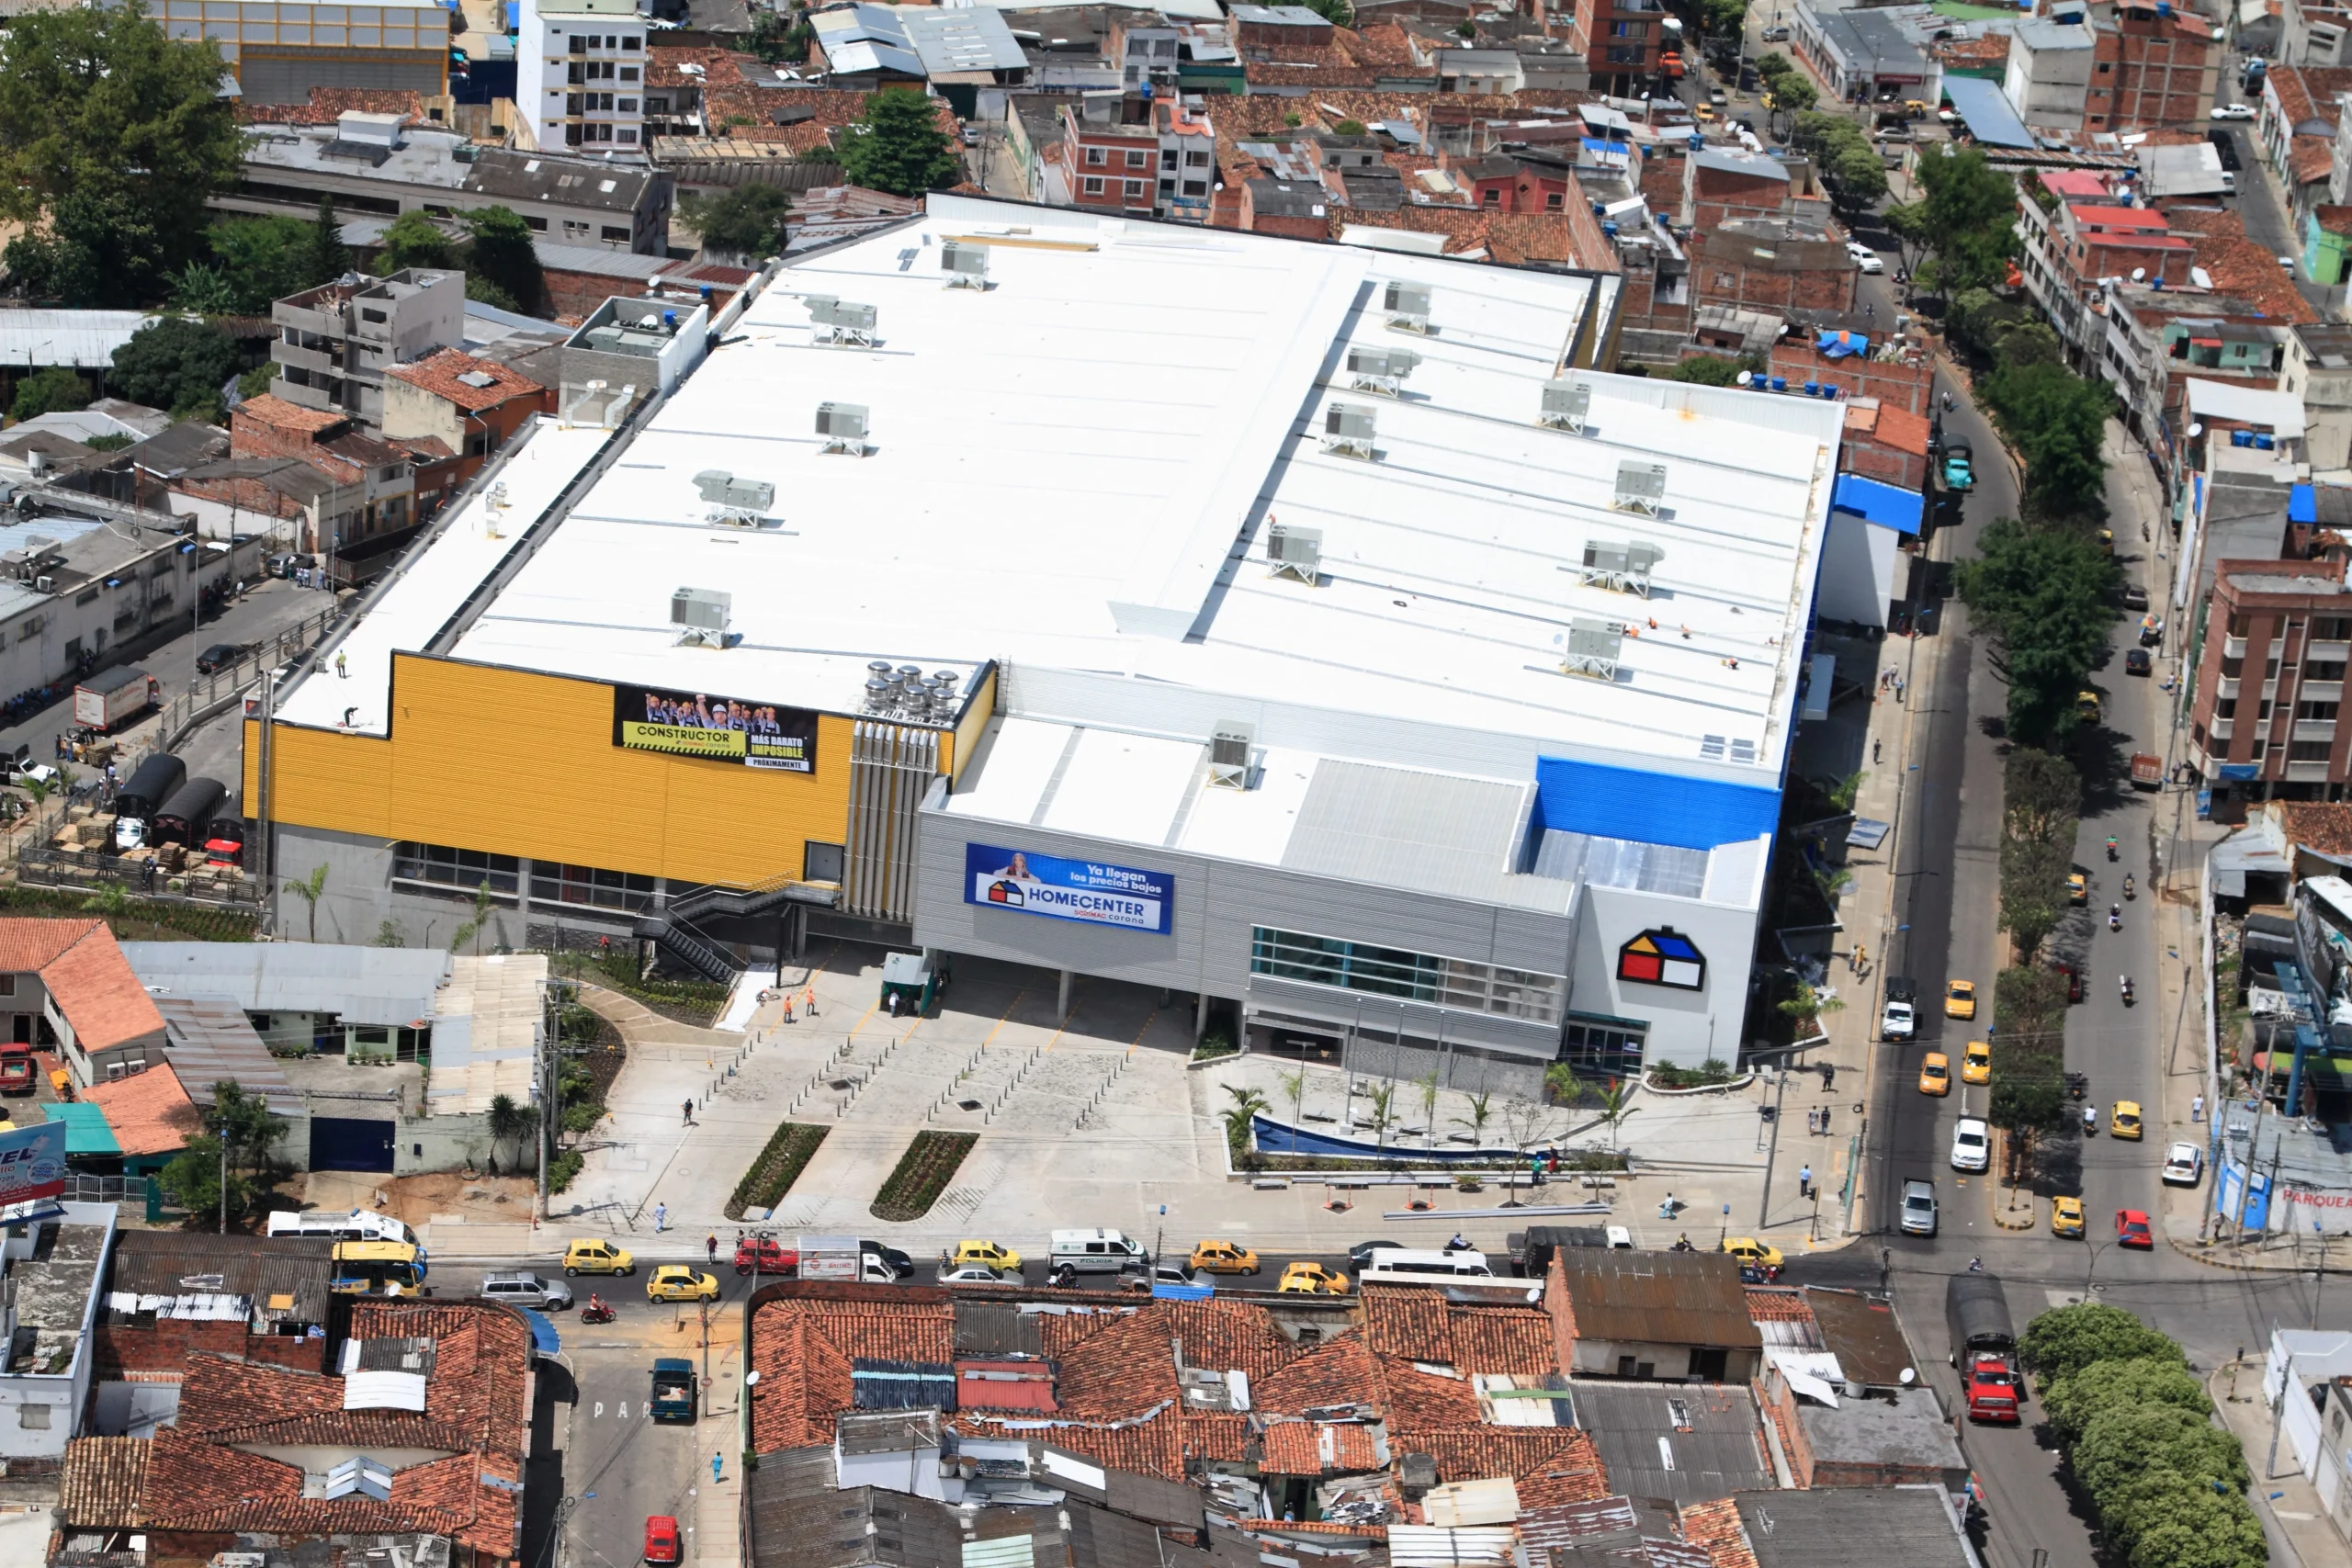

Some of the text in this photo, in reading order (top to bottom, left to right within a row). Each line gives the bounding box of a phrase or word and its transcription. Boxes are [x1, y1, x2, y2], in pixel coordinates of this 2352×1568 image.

[638, 726, 729, 742] CONSTRUCTOR
[751, 734, 803, 747] MÁS BARATO
[751, 744, 803, 759] IMPOSIBLE
[752, 759, 802, 769] PRÓXIMAMENTE
[1087, 864, 1147, 884] Ya llegan
[1070, 872, 1162, 894] los precios bajos
[1030, 888, 1144, 916] HOMECENTER
[1108, 914, 1144, 924] corona
[0, 1147, 32, 1165] EL
